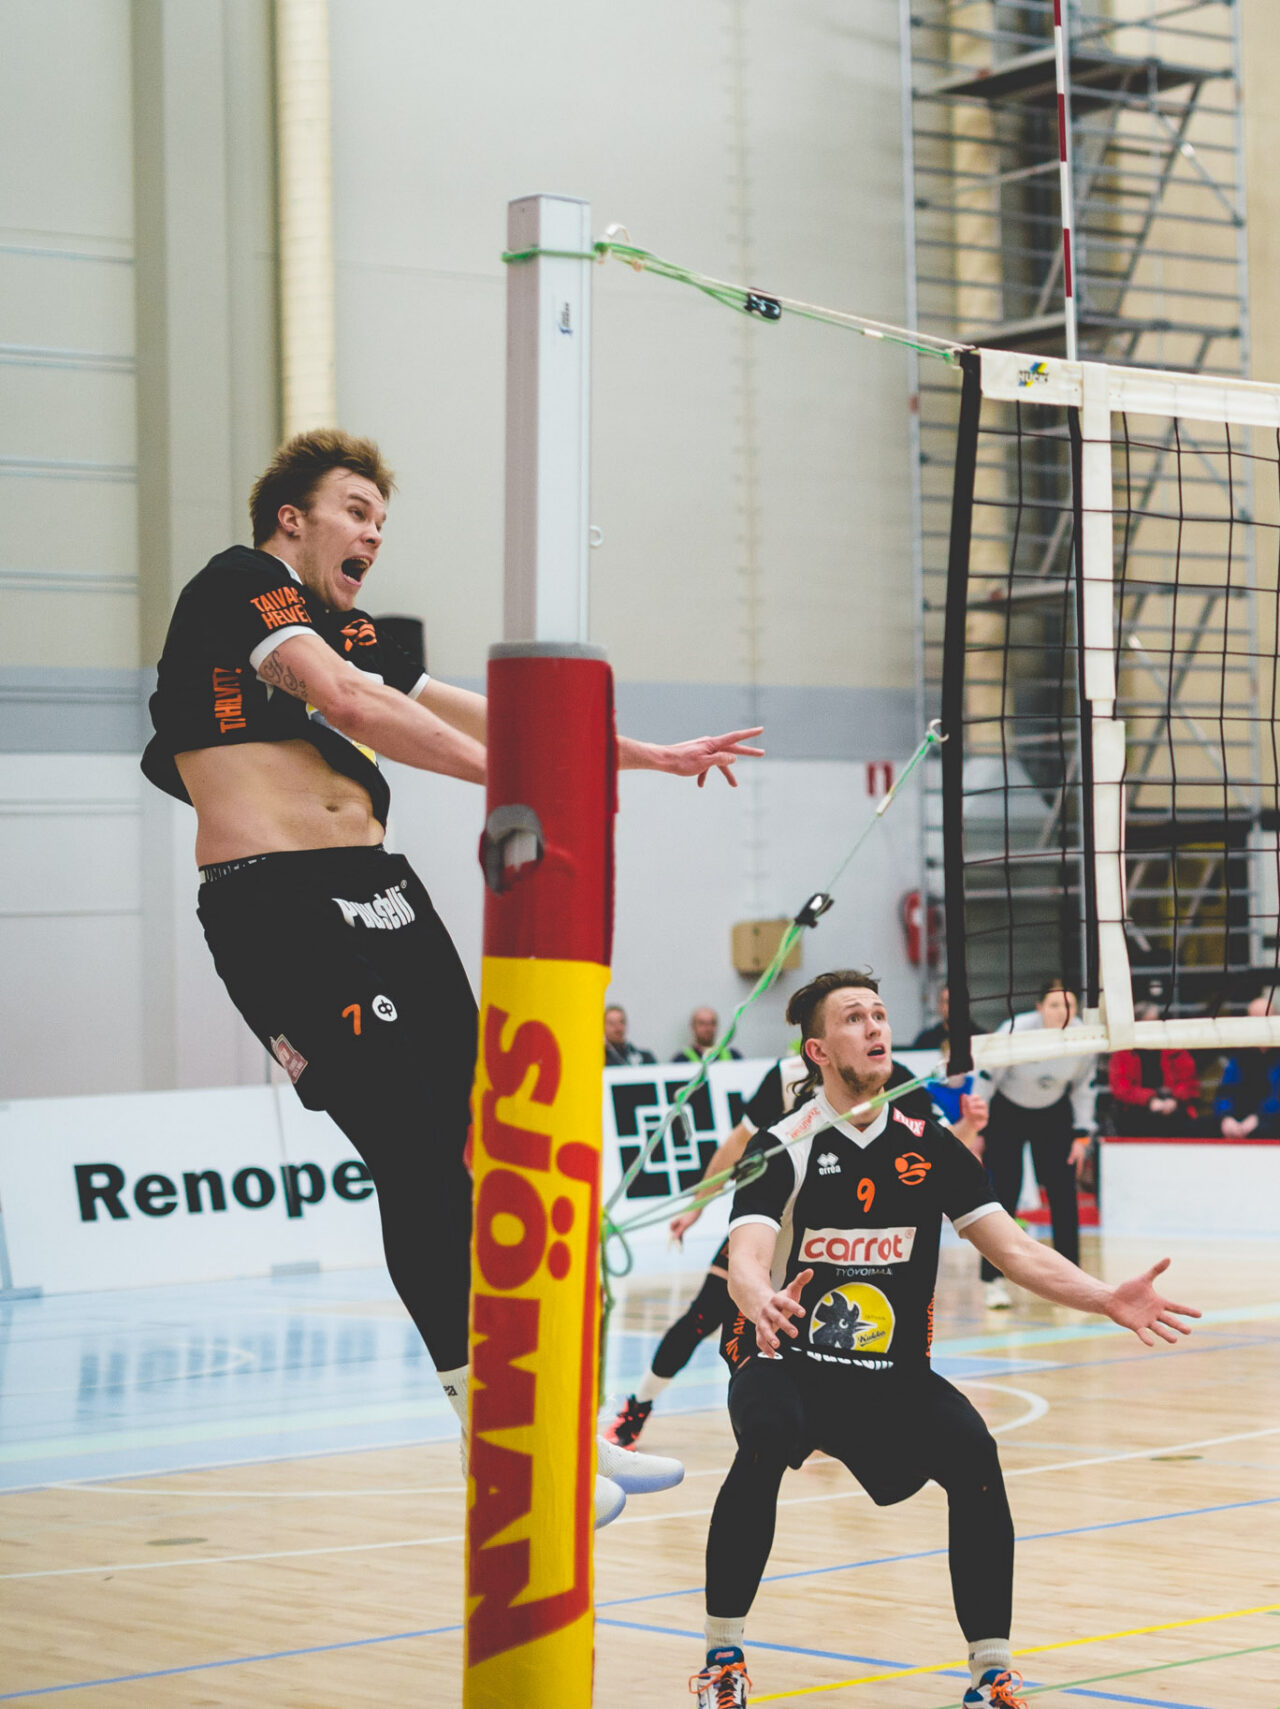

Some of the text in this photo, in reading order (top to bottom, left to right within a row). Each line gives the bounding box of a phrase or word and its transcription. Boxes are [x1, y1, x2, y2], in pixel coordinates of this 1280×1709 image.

[260, 604, 313, 630] HELVE
[74, 1160, 376, 1222] Renope
[856, 1177, 876, 1213] 9
[803, 1234, 904, 1262] carrot
[466, 1003, 598, 1668] SJÖMAN
